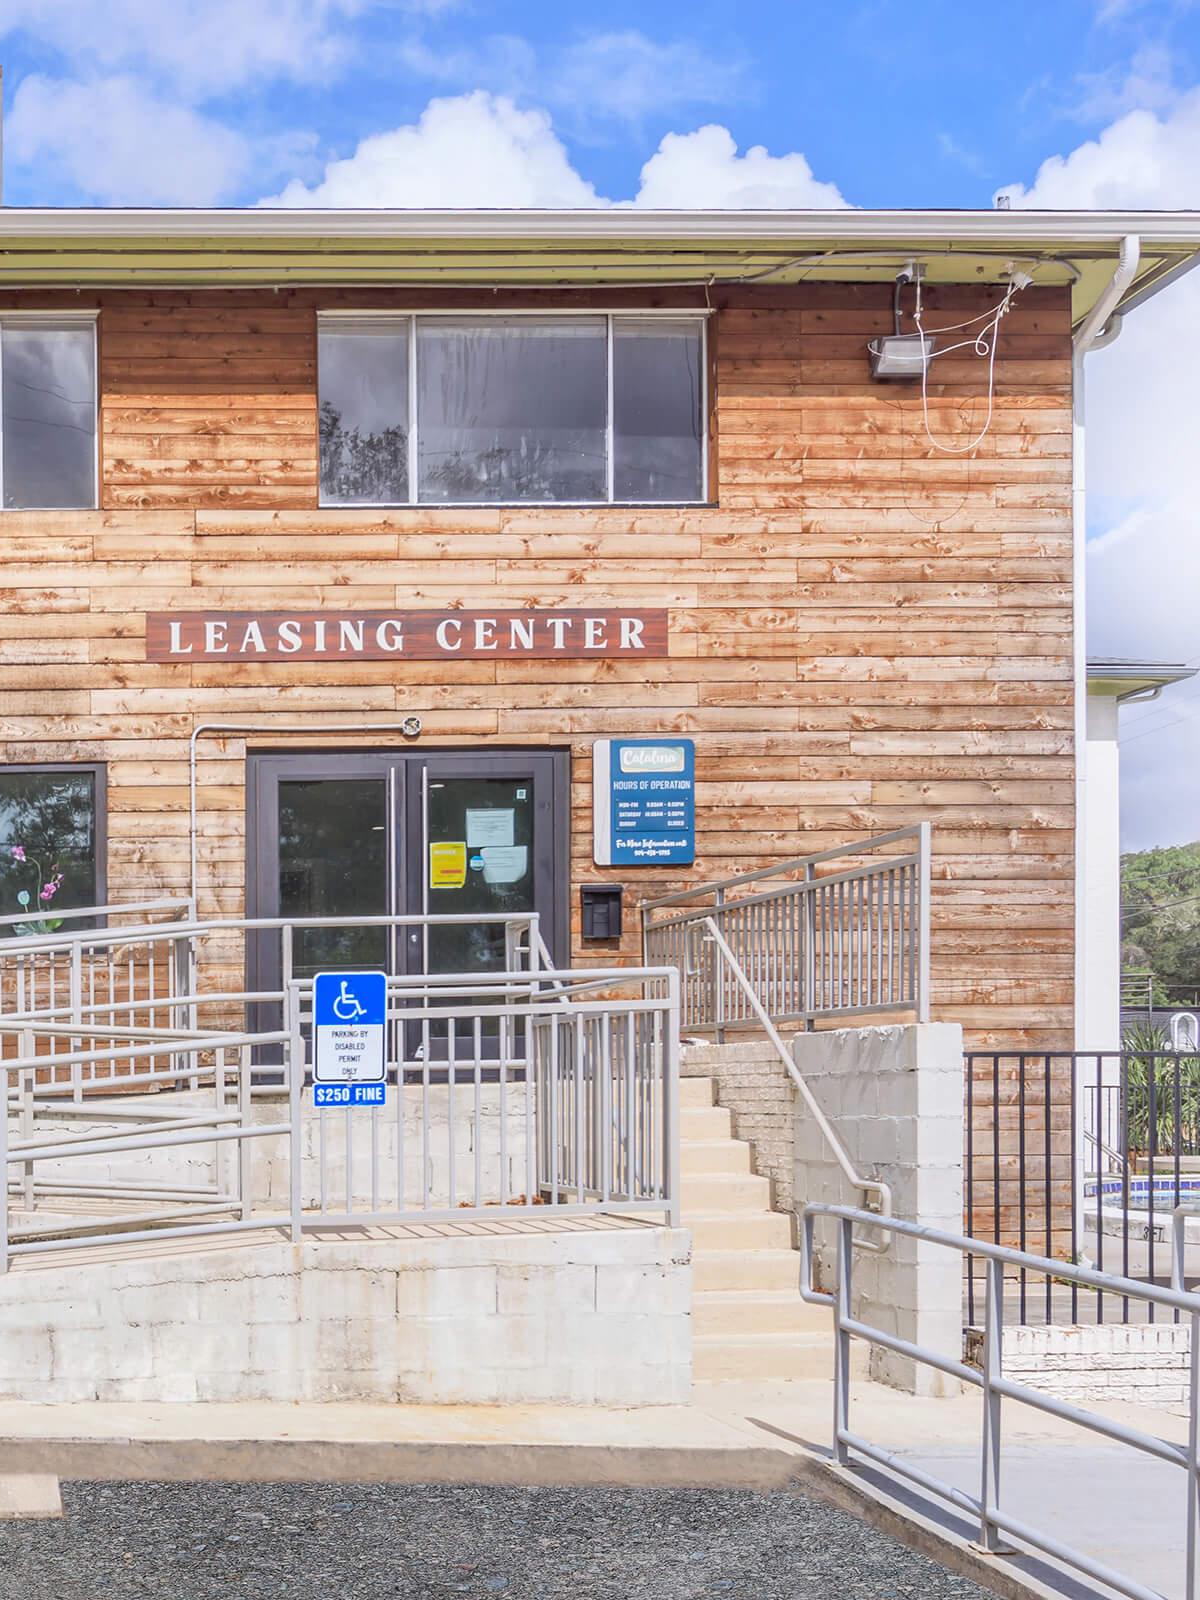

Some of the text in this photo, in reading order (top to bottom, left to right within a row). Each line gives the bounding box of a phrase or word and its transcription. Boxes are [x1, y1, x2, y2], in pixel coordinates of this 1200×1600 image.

[168, 617, 646, 654] LEASING CENTER
[623, 750, 676, 766] Catalina
[613, 780, 691, 790] HOURS OF OPERATION
[316, 1087, 383, 1102] $250 FINE
